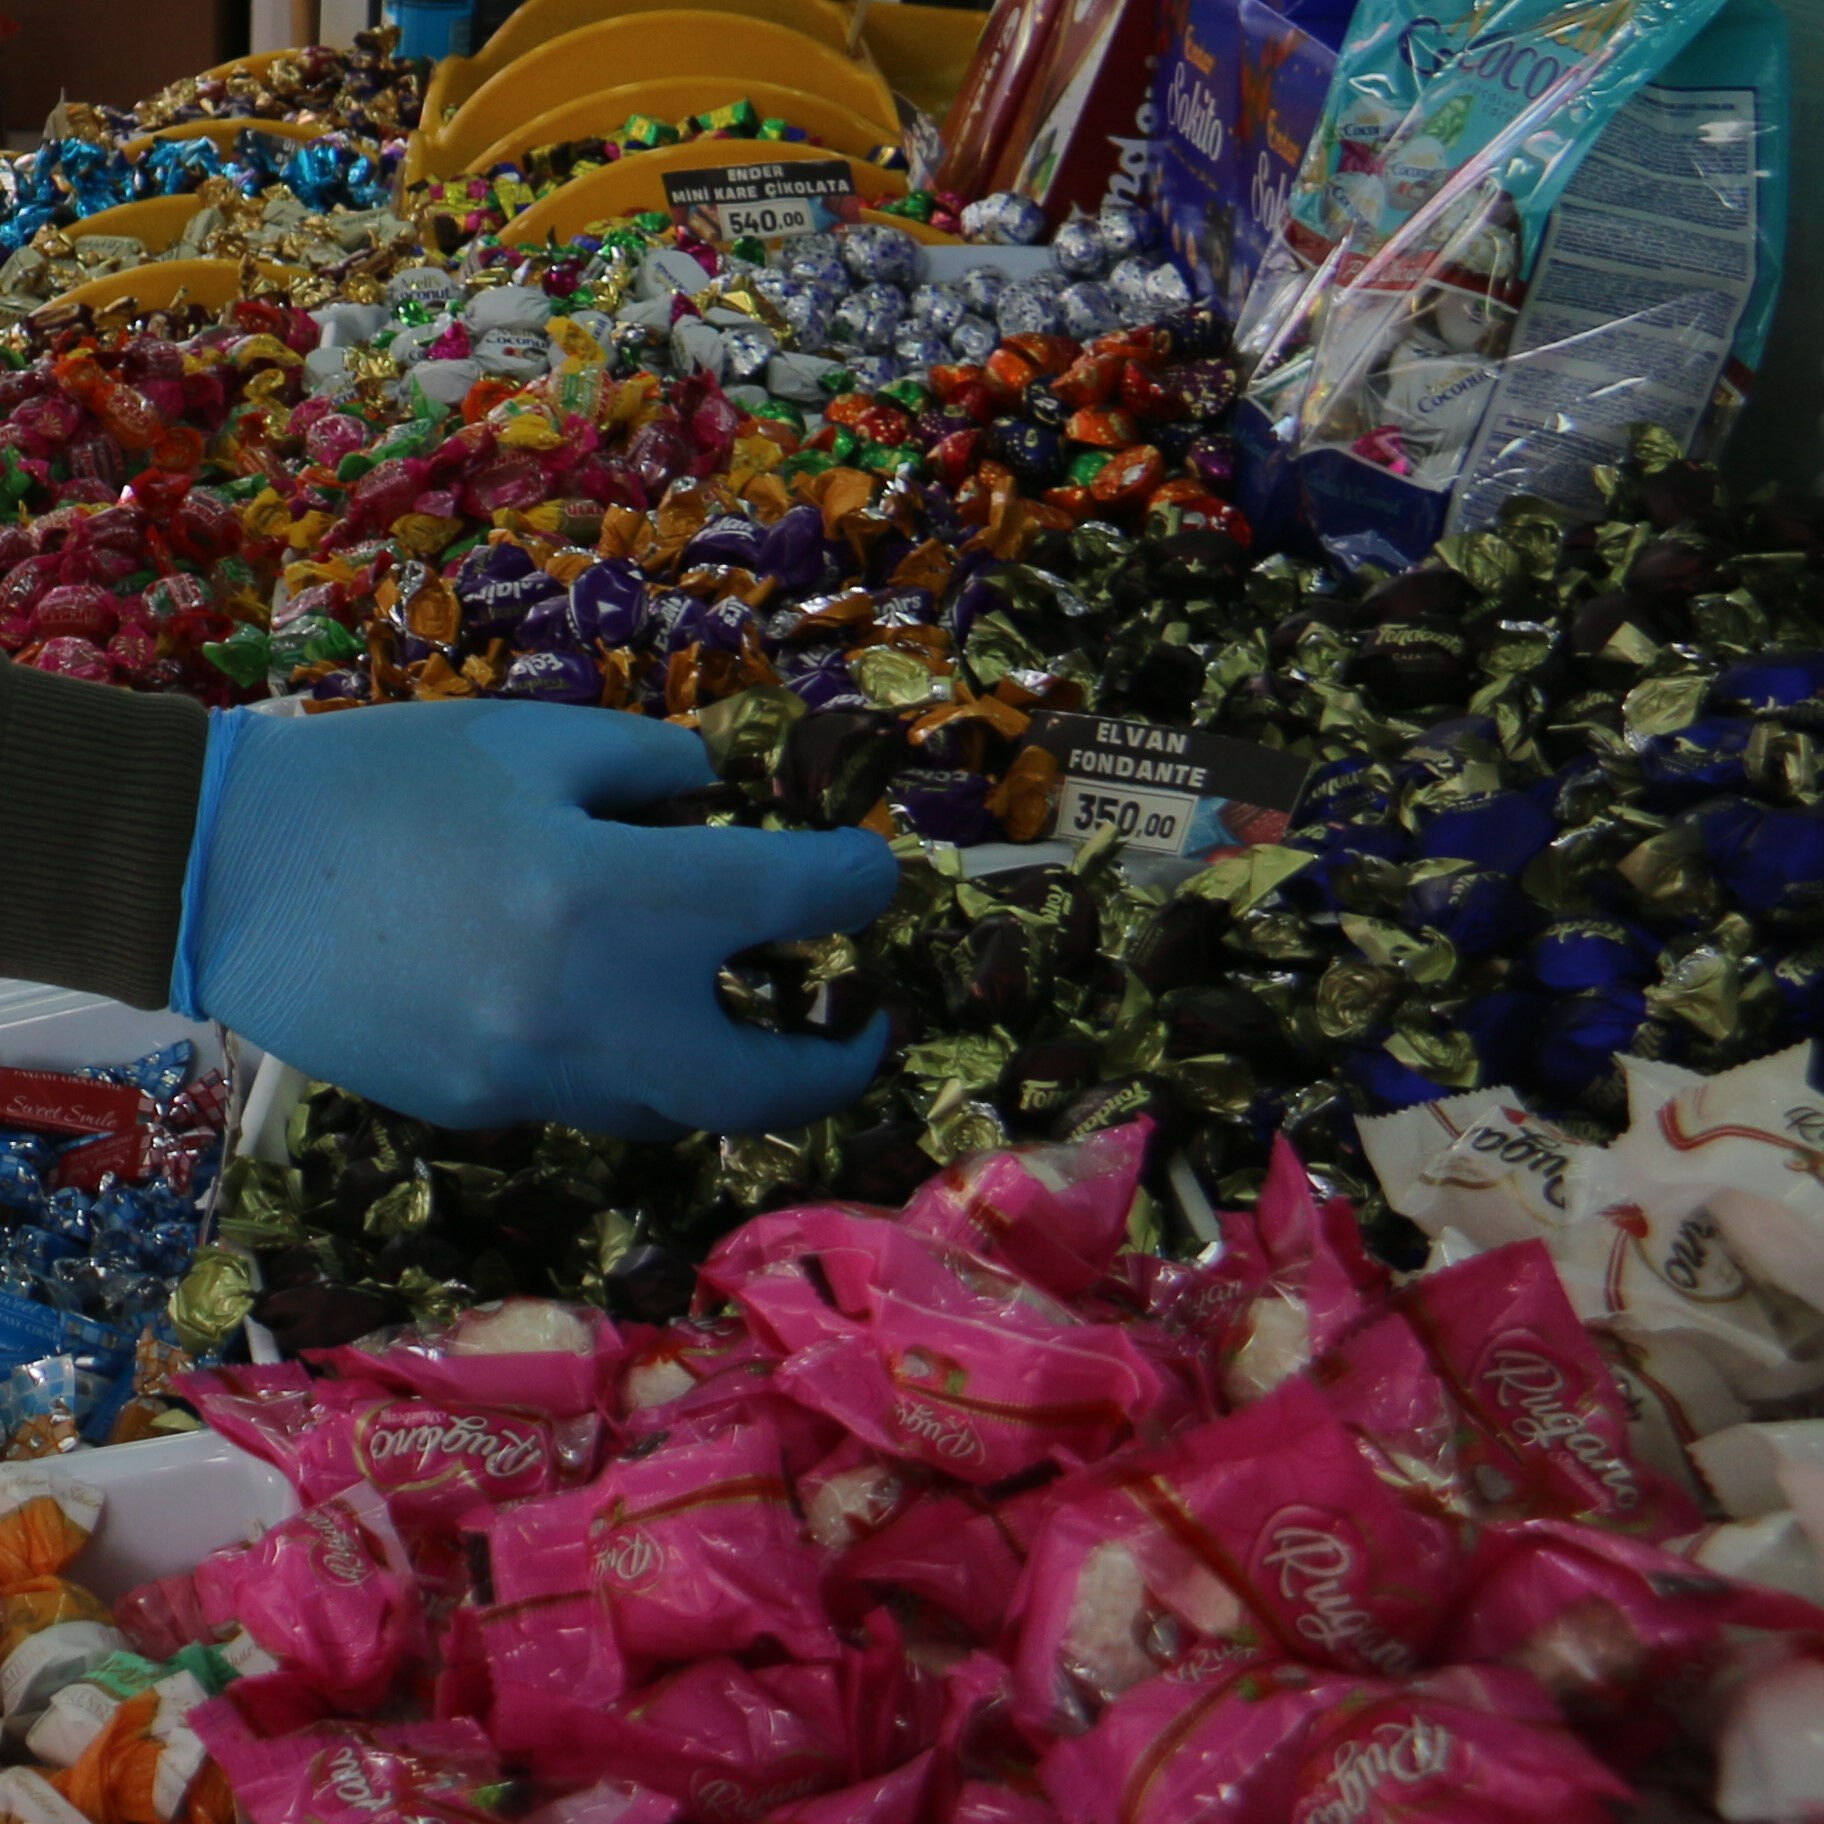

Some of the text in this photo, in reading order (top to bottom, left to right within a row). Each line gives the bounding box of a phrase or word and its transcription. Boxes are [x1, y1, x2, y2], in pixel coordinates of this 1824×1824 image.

[671, 179, 850, 203] MİNİ KARE ÇİKOLATA
[727, 165, 784, 182] ENDER
[1095, 720, 1189, 755] ELVAN
[1067, 748, 1208, 789] FONDANTE
[1072, 790, 1176, 840] 350,00
[5, 1094, 120, 1128] Sweet Smile
[369, 1414, 542, 1479] Rugano
[1263, 1524, 1430, 1676] Rugan
